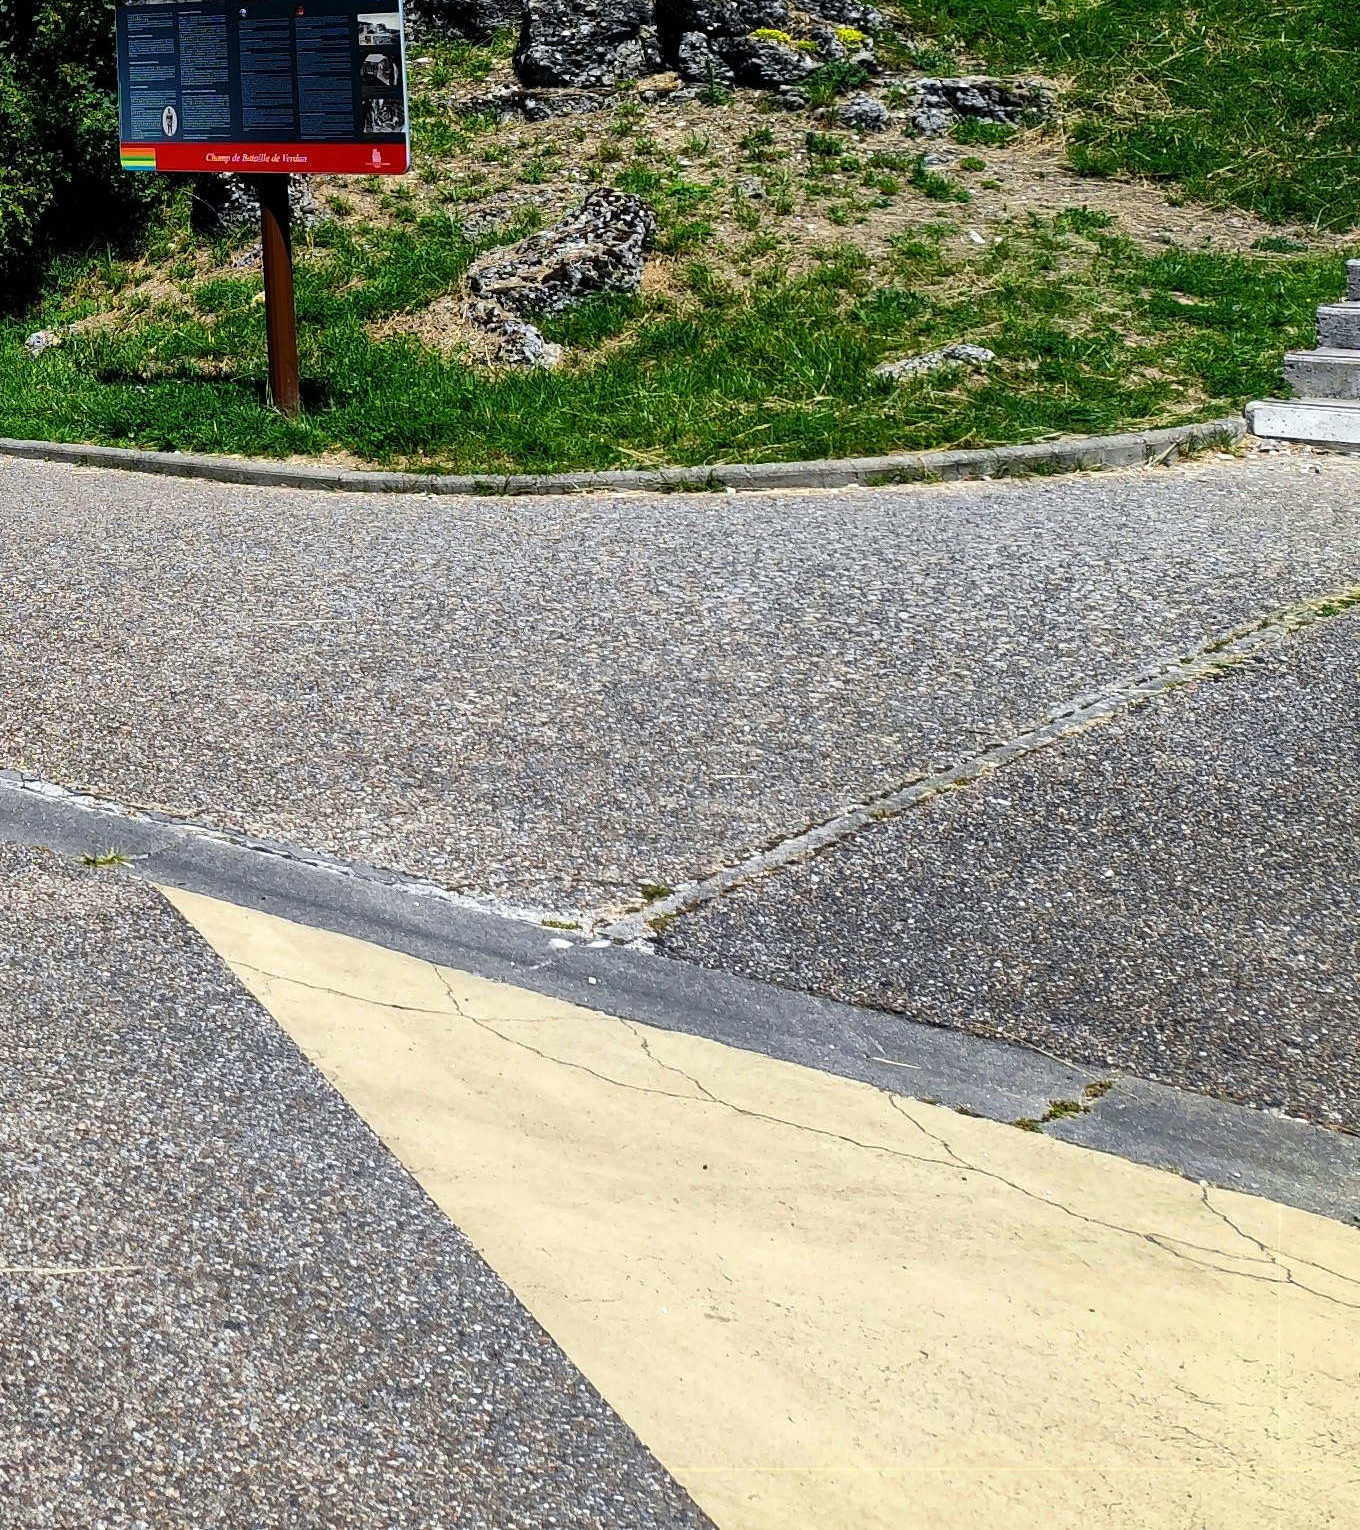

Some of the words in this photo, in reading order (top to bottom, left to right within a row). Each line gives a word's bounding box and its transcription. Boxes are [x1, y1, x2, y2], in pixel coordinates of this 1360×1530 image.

[206, 153, 230, 164] Champ
[232, 153, 240, 162] de
[242, 154, 269, 162] Bataille
[271, 154, 280, 162] de
[282, 154, 308, 162] Verdun
